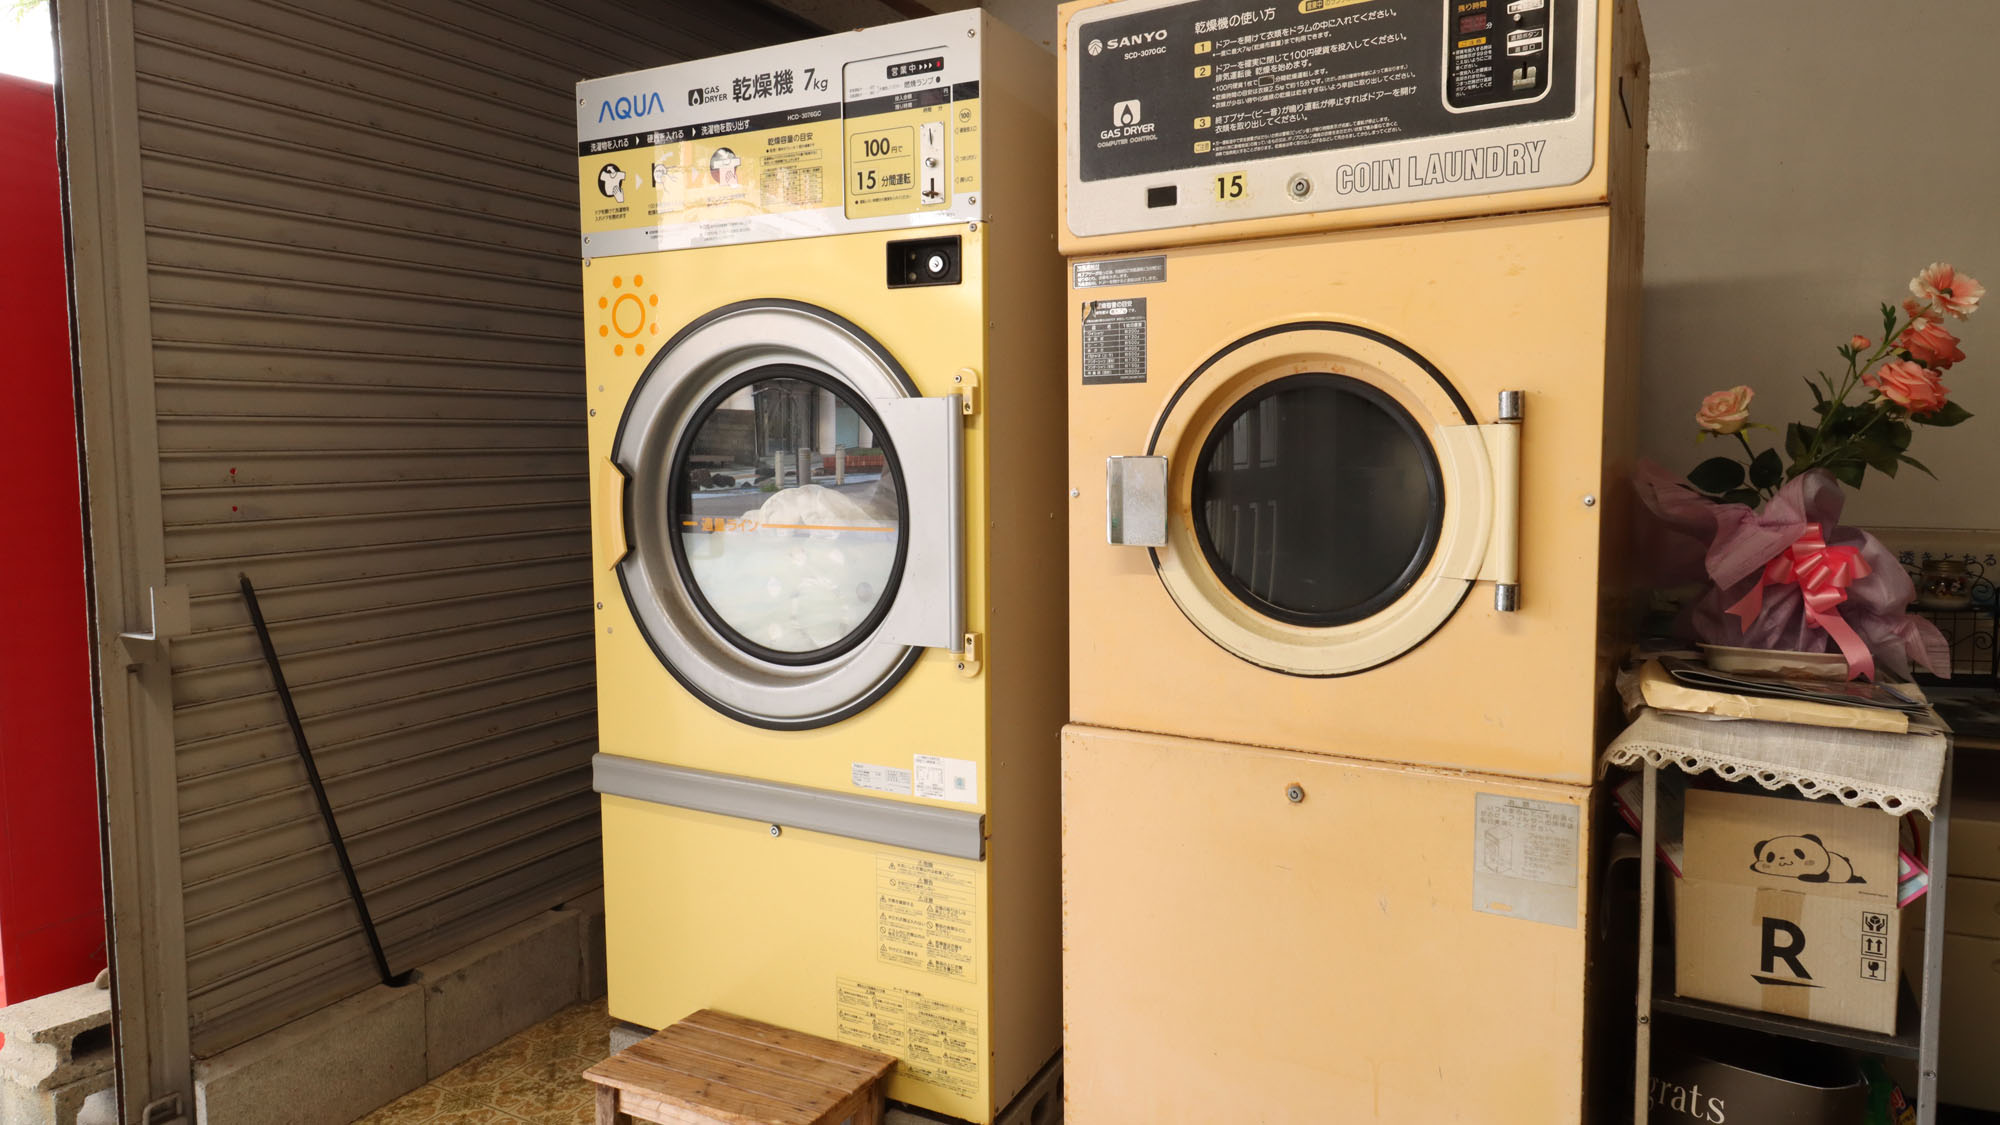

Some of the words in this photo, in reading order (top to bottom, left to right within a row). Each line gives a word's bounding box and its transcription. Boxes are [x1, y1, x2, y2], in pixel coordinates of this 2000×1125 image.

[1194, 7, 1276, 34] 乾燥機の使い方
[1486, 21, 1492, 29] 分
[1200, 43, 1205, 51] 1
[1215, 9, 1397, 49] ドアーを開けて衣類をドラムの中に入れてください。
[1106, 29, 1168, 50] SANYO
[1124, 46, 1167, 60] SCD-3070GC
[1200, 67, 1206, 76] 2
[1215, 33, 1407, 73] ドアーを確実に閉じて100円硬貨を投入してください。
[891, 64, 916, 76] 営業中
[1255, 59, 1312, 76] 乾燥を始めます。
[704, 85, 720, 95] GAS
[732, 69, 794, 103] 乾燥機
[803, 68, 829, 92] 7kg
[598, 92, 665, 123] AQUA
[704, 93, 728, 104] DRYER
[700, 119, 750, 136] 洗濯物を取り出す
[1100, 128, 1121, 139] GAS
[1123, 123, 1155, 136] DRYER
[1199, 118, 1206, 127] 3
[1215, 113, 1308, 134] 衣類を取り出してください。
[590, 138, 629, 152] 洗濯物を入れる
[767, 132, 814, 146] 乾燥容量の目安
[1097, 138, 1129, 148] COMPUTER
[1335, 158, 1401, 196] COIN
[1408, 140, 1547, 187] LAUNDRY
[857, 170, 876, 190] 15
[881, 173, 911, 187] 分間運転
[1217, 174, 1244, 199] 15
[1760, 916, 1813, 980] R
[1649, 1077, 1725, 1124] rats
